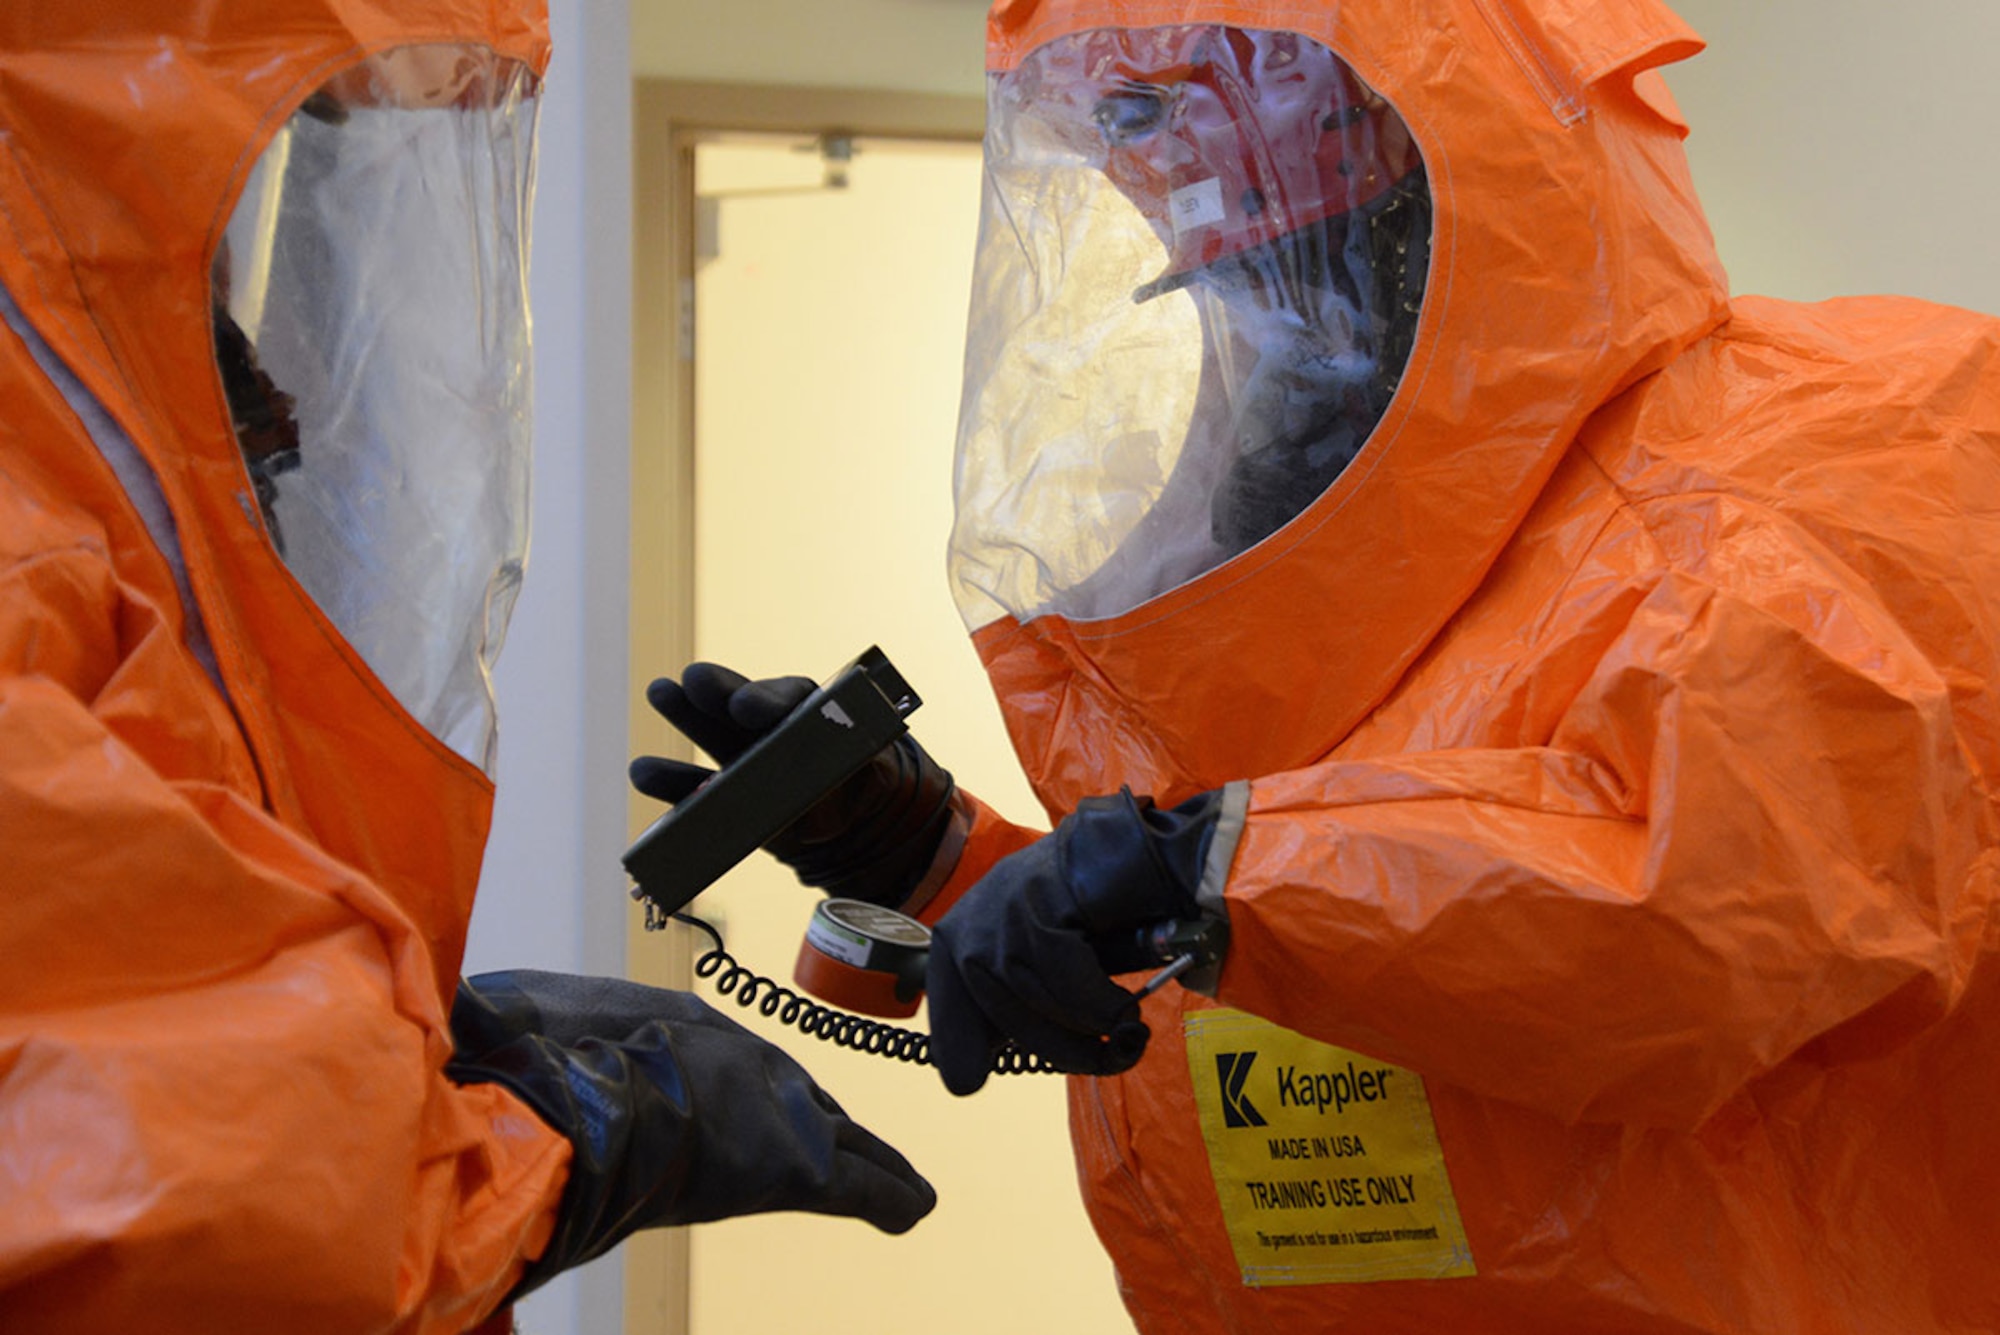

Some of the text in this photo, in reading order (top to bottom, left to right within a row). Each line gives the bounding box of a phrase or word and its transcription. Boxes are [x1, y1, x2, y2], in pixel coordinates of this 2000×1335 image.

[1268, 1135, 1366, 1160] MADE IN USA
[1246, 1174, 1416, 1210] TRAINING USE ONLY
